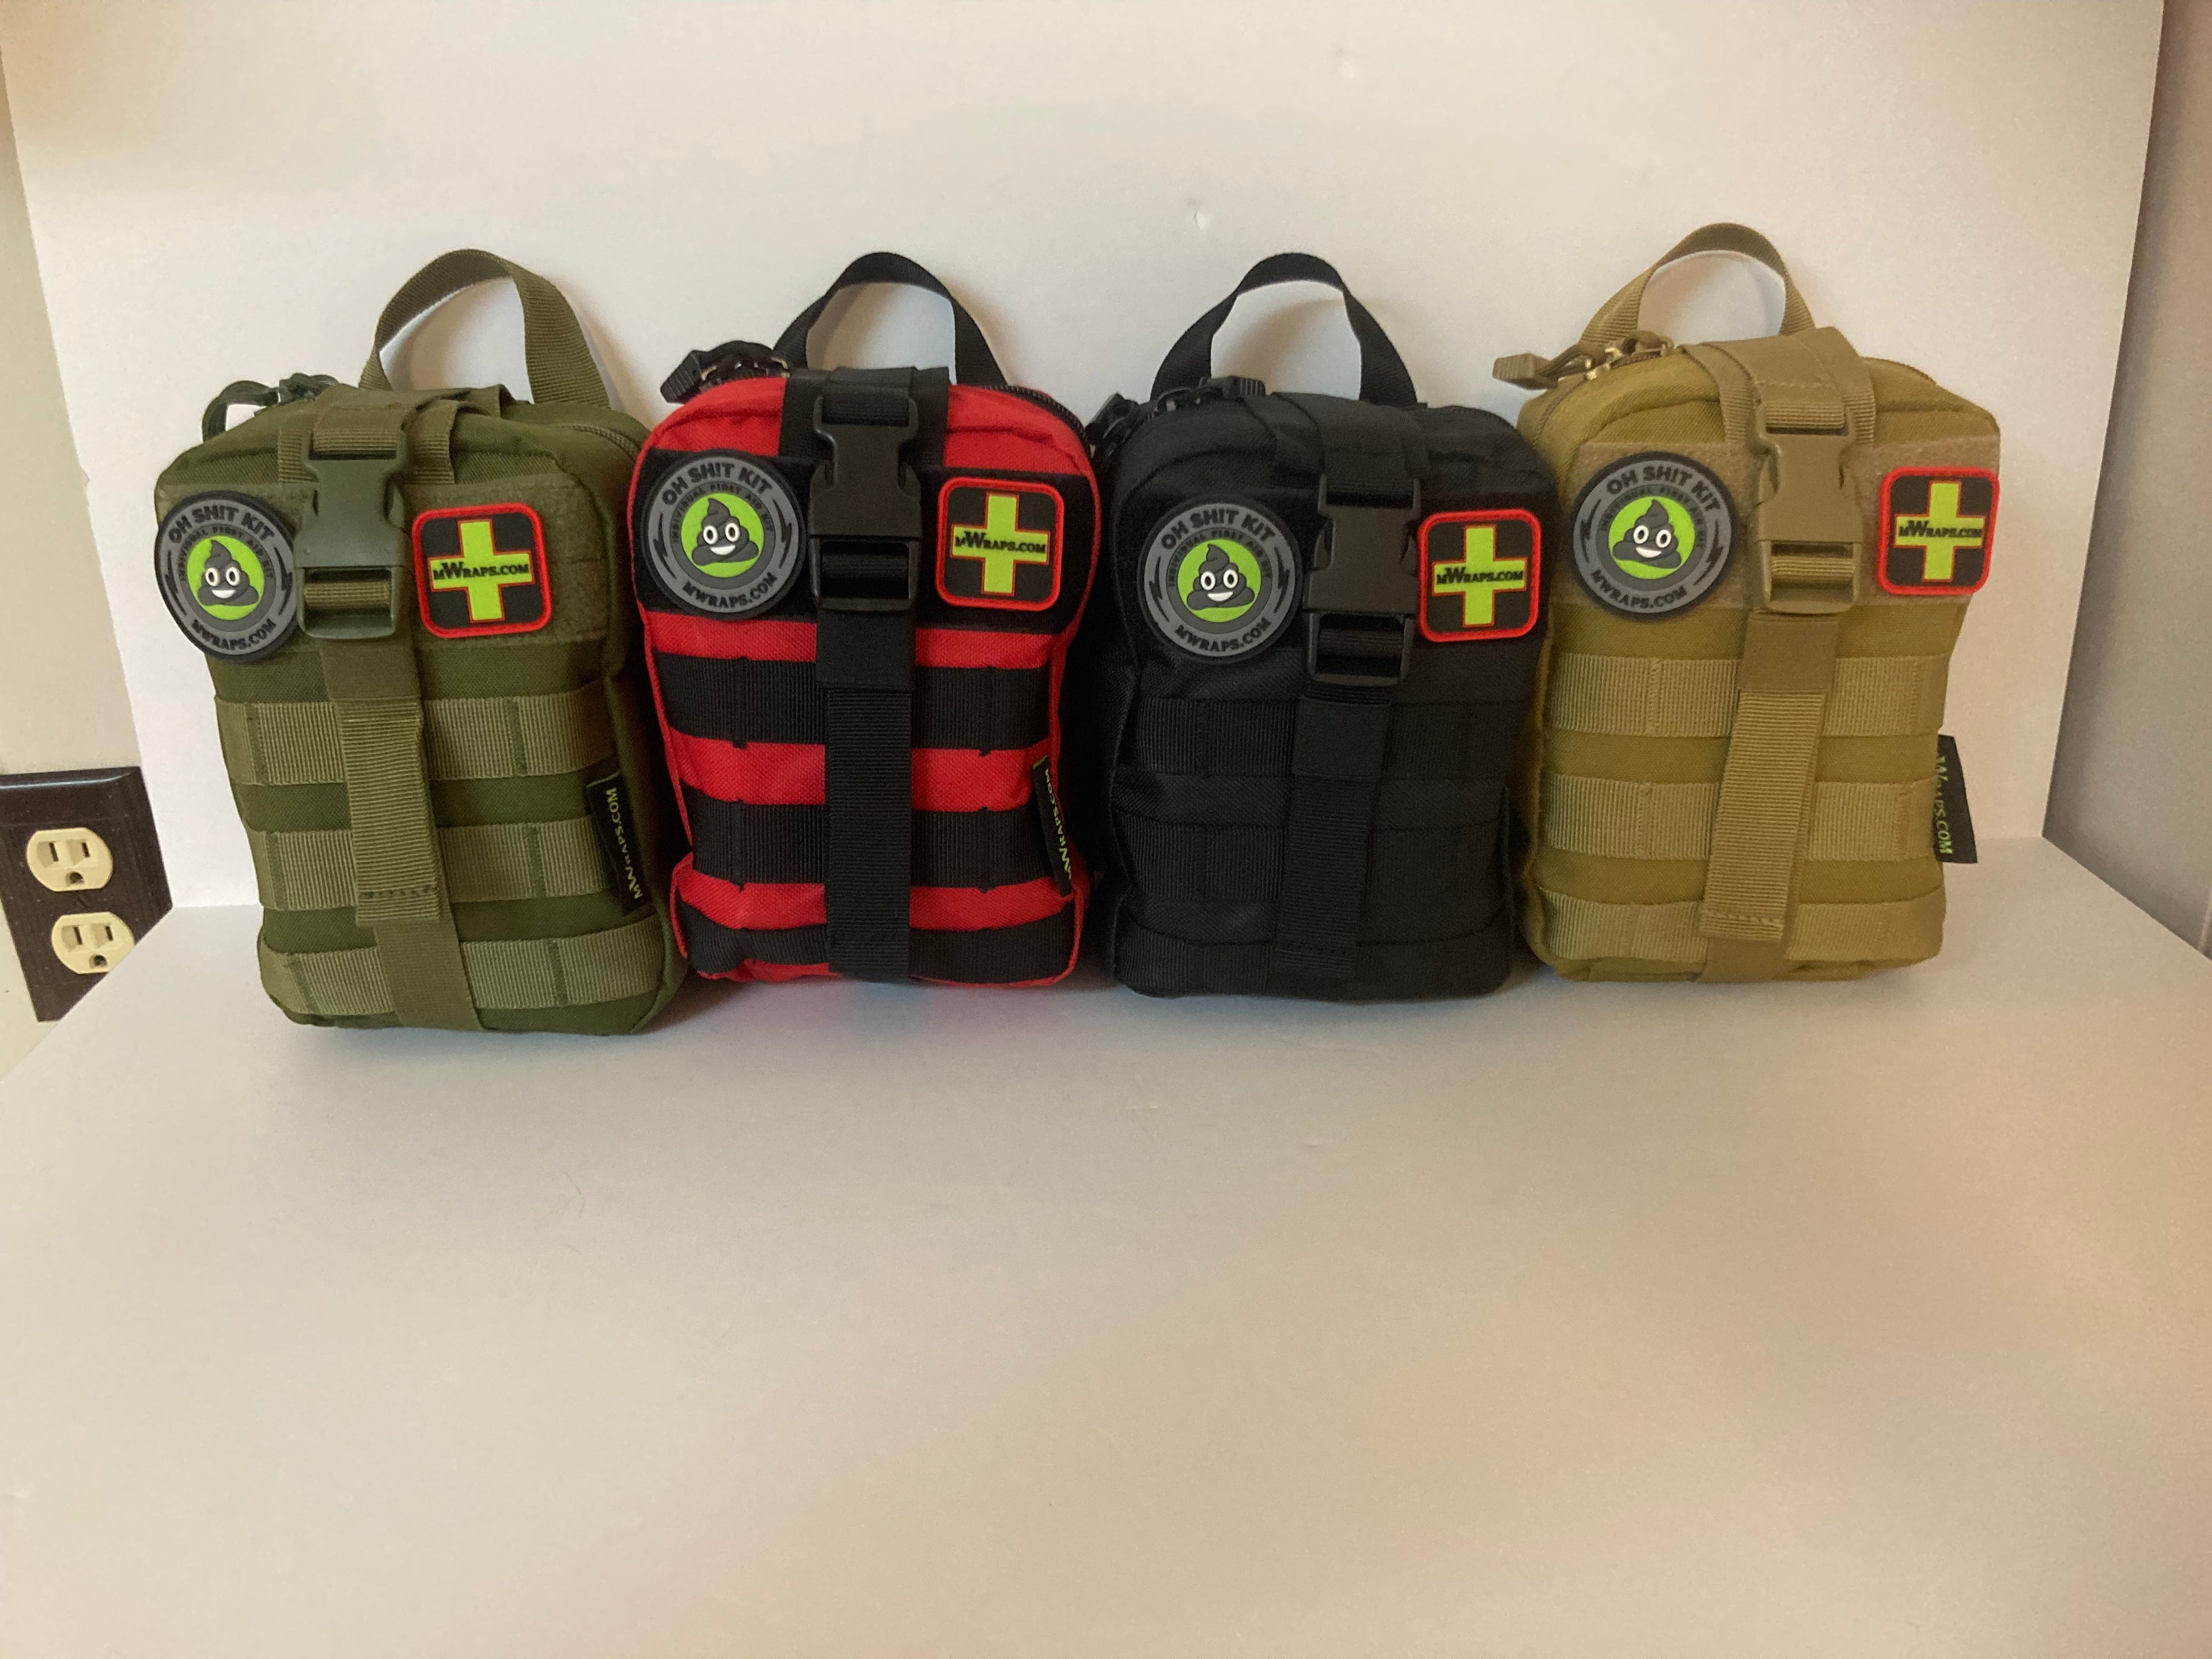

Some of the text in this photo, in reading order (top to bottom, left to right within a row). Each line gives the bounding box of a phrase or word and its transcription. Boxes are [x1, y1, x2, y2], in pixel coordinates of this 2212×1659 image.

[662, 462, 772, 505] OH SHIT KIT
[1607, 465, 1721, 512] OH SHIT KIT
[168, 505, 275, 543] OH SHIT KIT
[1161, 508, 1275, 549] OH SHIT KIT
[683, 571, 778, 609] MWRAPS.COM
[1590, 569, 1688, 609] MWRAPS.COM
[192, 618, 276, 650] MWRAPS.COM
[1174, 617, 1272, 652] MWRAPS.COM
